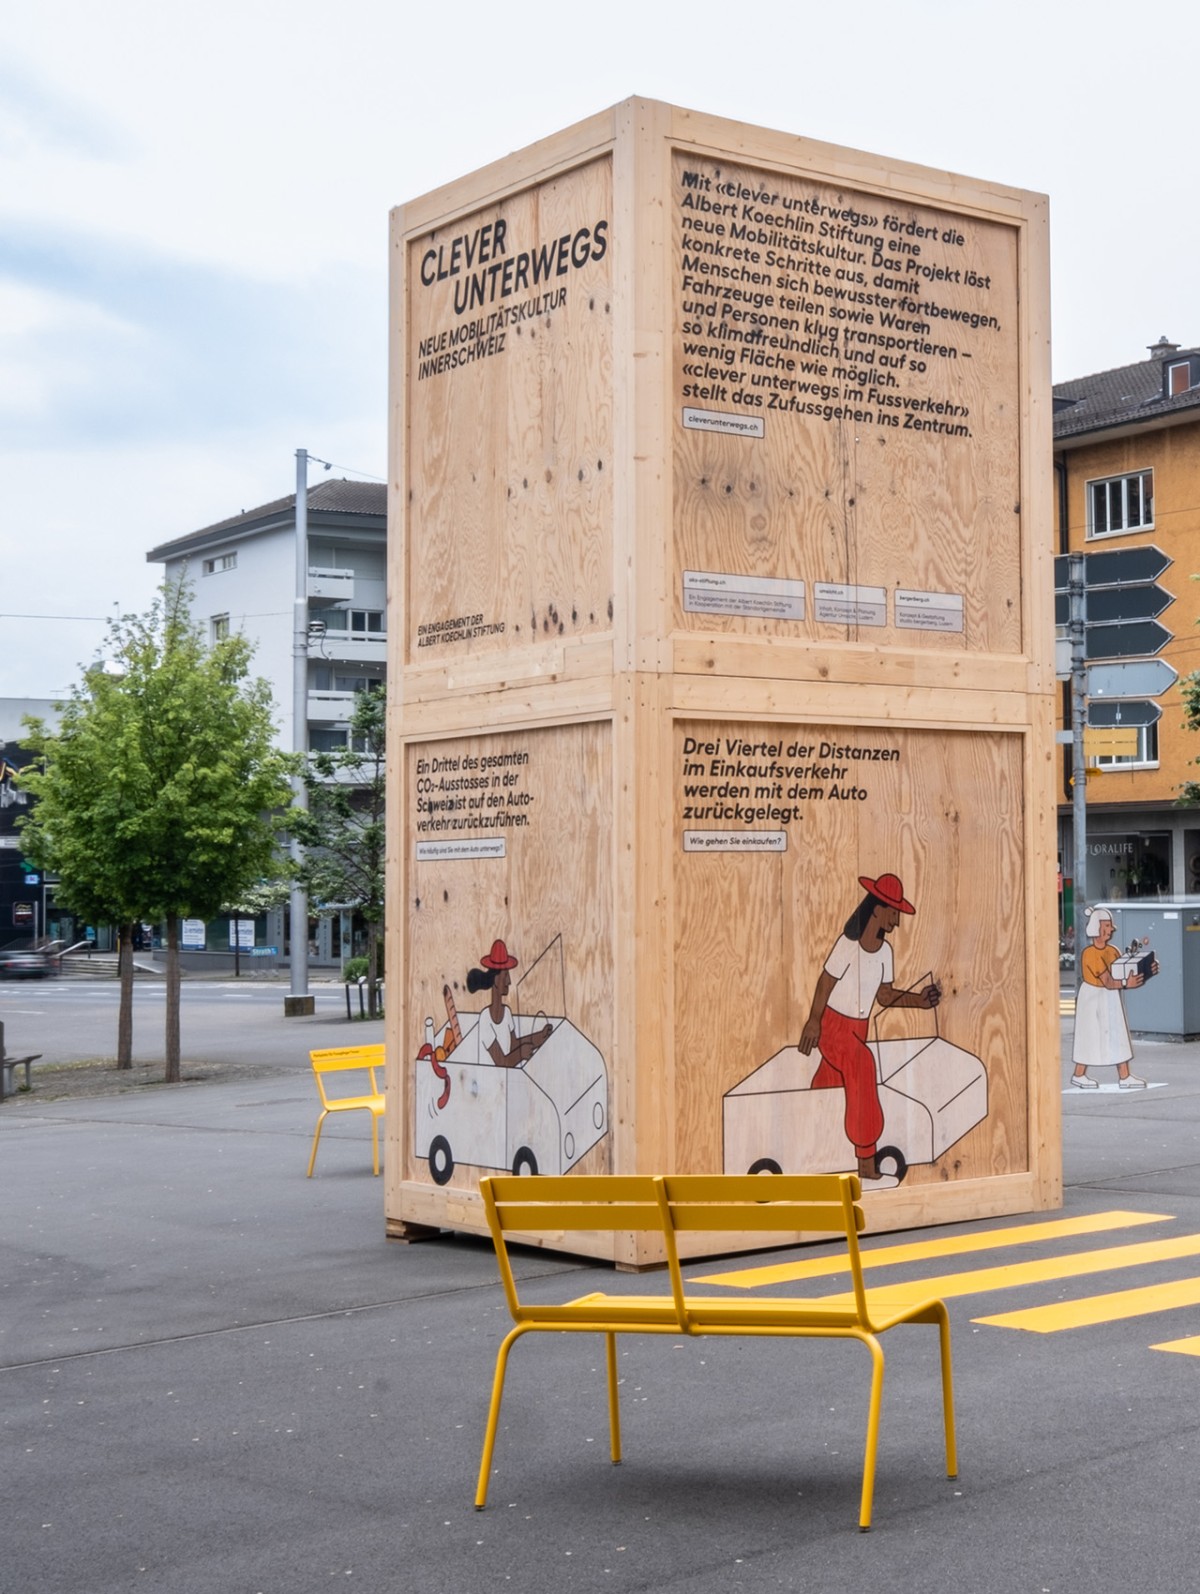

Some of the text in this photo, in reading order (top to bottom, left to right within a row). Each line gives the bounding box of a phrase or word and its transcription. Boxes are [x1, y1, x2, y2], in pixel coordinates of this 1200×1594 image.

[681, 170, 964, 246] Mit «clever unterwegs» fördert die
[681, 192, 920, 256] Albert Koechlin Stiftung eine
[421, 219, 507, 287] CLEVER
[454, 220, 608, 315] UNTERWEGS
[682, 217, 991, 289] neue Mobilitätskultur. Das Projekt löst
[682, 234, 919, 295] konkrete Schritte aus, damit
[682, 254, 1001, 331] Menschen sich bewusster fortbewegen,
[682, 275, 930, 335] Fahrzeuge teilen sowie Waren
[418, 287, 567, 359] NEUE MOBILITÄTSKULTUR
[682, 321, 926, 373] so klimafreundlich und auf so
[683, 301, 957, 358] und Personen klug transportieren
[418, 333, 506, 381] INNERSCHWEIZ
[683, 342, 900, 388] wenig Fläche wie möglich.
[682, 384, 972, 438] stellt das Zufussgehen ins Zentrum.
[683, 362, 969, 417] «clever unterwegs im Fussverkehr»
[688, 415, 758, 431] cleverunterwegs.ch
[418, 614, 483, 636] EIN ENGAGEMENT DER
[418, 622, 505, 648] ALBERT KOECHLIN STIFTUNG
[417, 752, 529, 774] Ein Drittel des gesamten
[683, 737, 900, 761] Drei Viertel der Distanzen
[683, 759, 848, 779] im Einkaufsverkehr
[417, 791, 534, 812] Schweiz ist auf den Auto-
[492, 772, 500, 787] in
[502, 771, 518, 786] der
[685, 782, 867, 801] werden mit dem Auto
[417, 811, 529, 832] verkehr zurückzuführen.
[683, 803, 804, 824] zurückgelegt.
[690, 837, 782, 846] Wie gehen Sie einkaufen?
